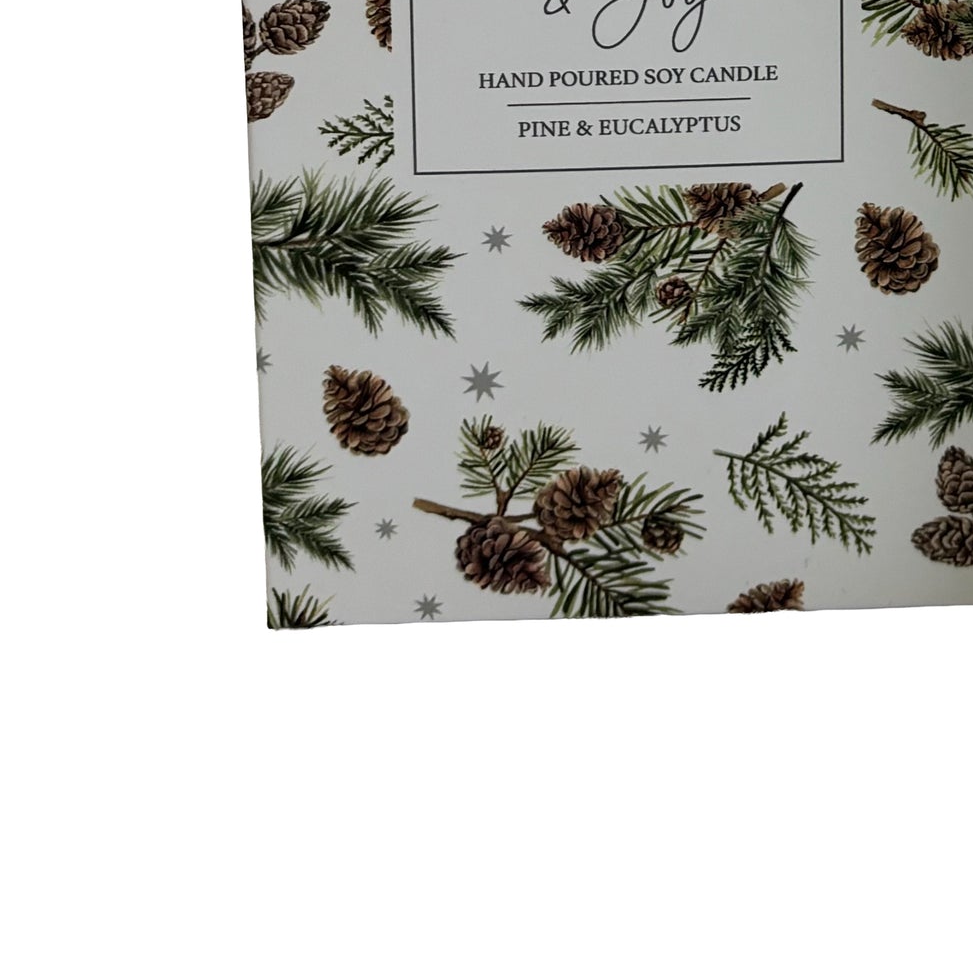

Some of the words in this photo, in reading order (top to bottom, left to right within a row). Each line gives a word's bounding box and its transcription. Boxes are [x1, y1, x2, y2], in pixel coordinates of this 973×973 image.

[478, 71, 544, 90] HAND
[548, 69, 640, 88] POURED
[643, 67, 687, 85] SOY
[689, 64, 779, 84] CANDLE
[517, 120, 572, 138] PINE
[575, 119, 594, 137] &
[598, 114, 742, 136] EUCALYPTUS
